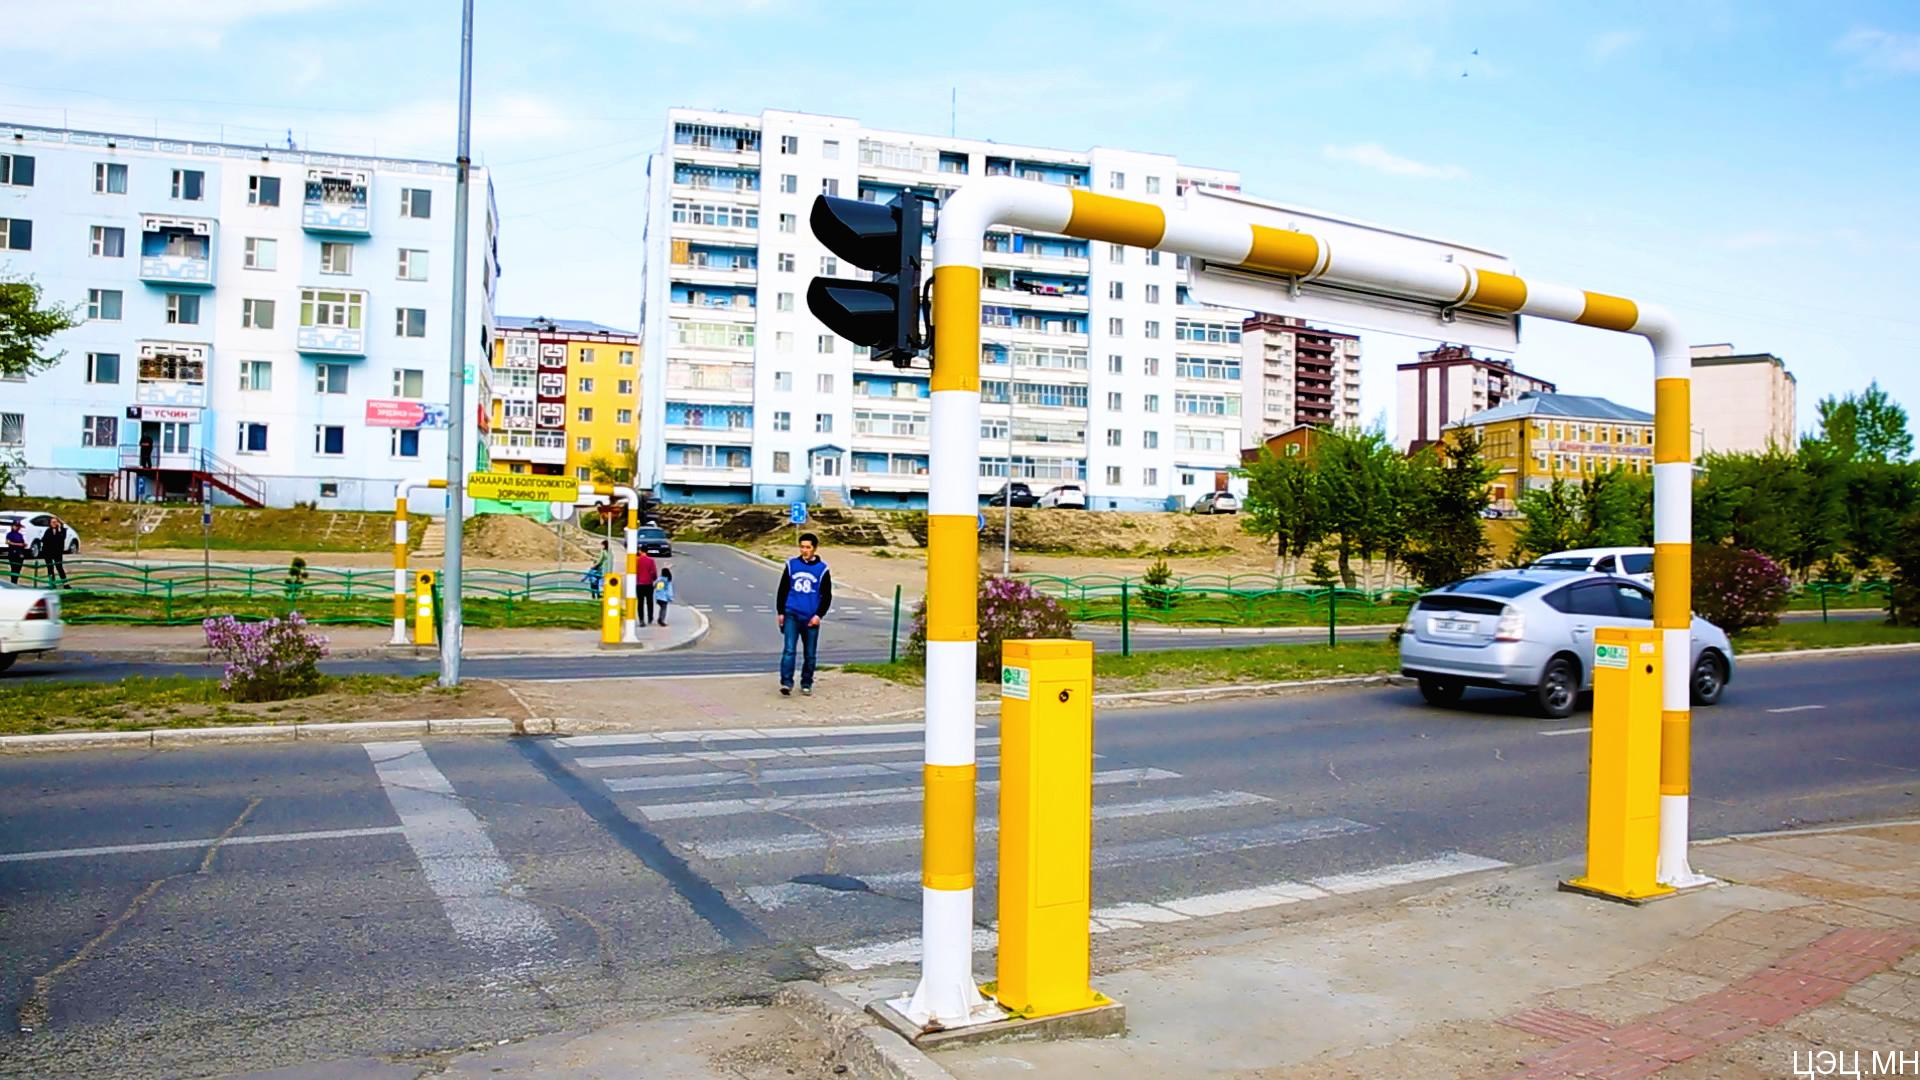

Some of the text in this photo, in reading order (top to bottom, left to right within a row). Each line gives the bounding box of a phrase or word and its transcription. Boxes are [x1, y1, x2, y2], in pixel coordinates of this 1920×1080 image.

[470, 475, 514, 486] АНХААРАЛ
[497, 489, 536, 500] ЗОРЧИНО
[794, 578, 812, 593] 68
